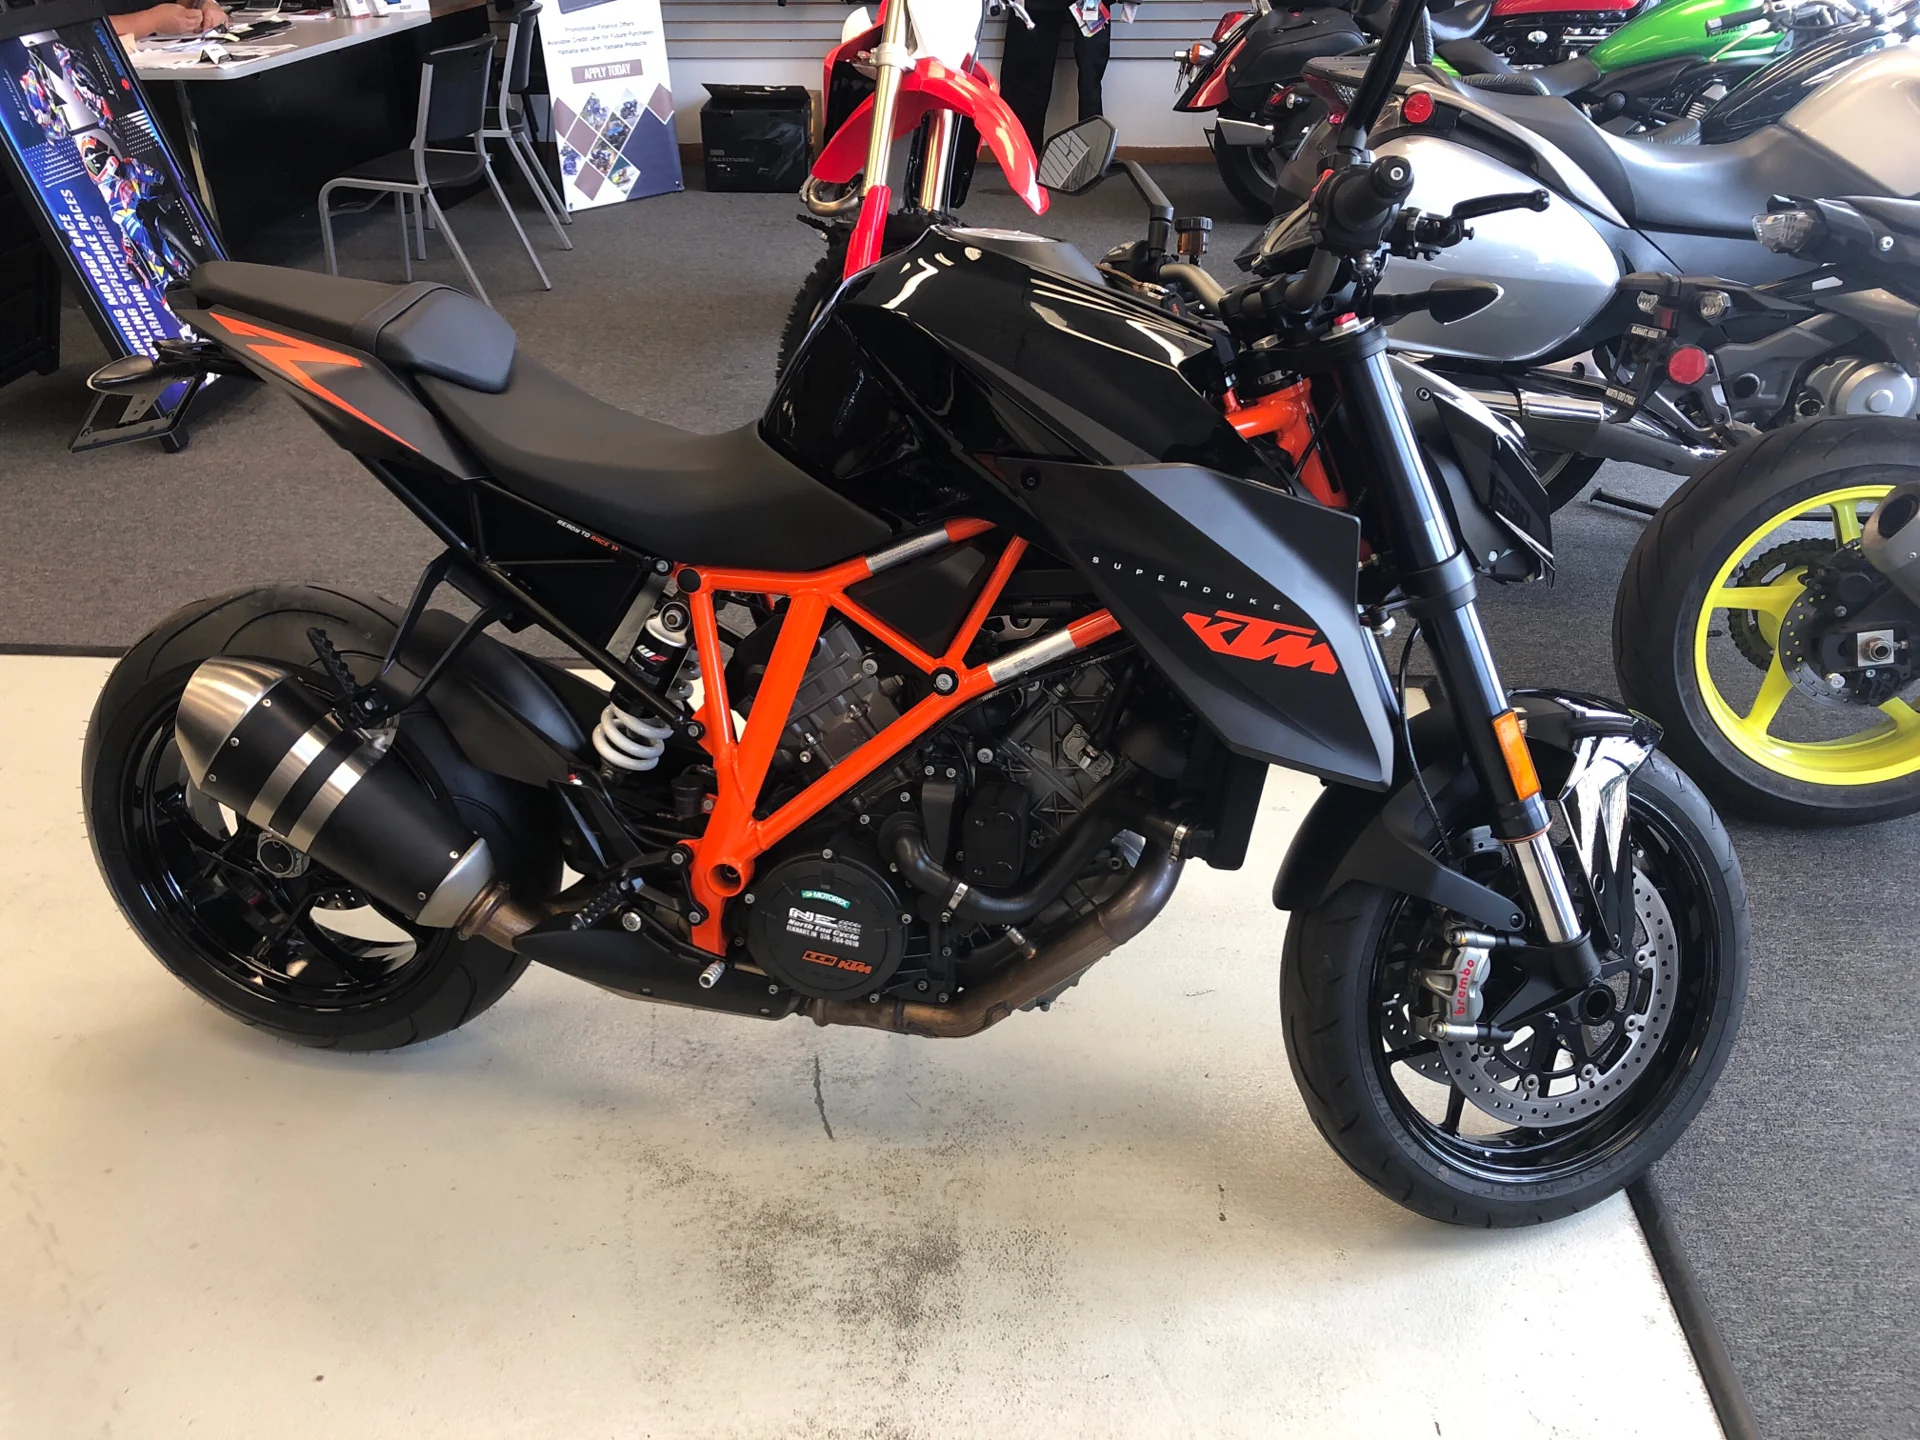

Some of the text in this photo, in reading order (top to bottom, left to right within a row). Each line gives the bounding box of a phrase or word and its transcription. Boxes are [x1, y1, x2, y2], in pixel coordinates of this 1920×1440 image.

[94, 28, 124, 76] SUZUKI
[584, 63, 631, 80] APPLY TODAY
[58, 213, 149, 358] UNNING MOTOGP RACE
[60, 189, 160, 361] RILLING SUPERBIKE RACES
[90, 215, 168, 340] ARATING VICTORIES
[556, 519, 610, 547] READY TO RACE
[1091, 555, 1283, 611] SUPERDUKE
[636, 644, 668, 662] WP
[1182, 609, 1339, 675] KTM
[812, 890, 848, 908] MOTOREX
[787, 918, 860, 941] North End Cycle
[837, 959, 873, 974] KTM
[1453, 959, 1475, 1017] brembo
